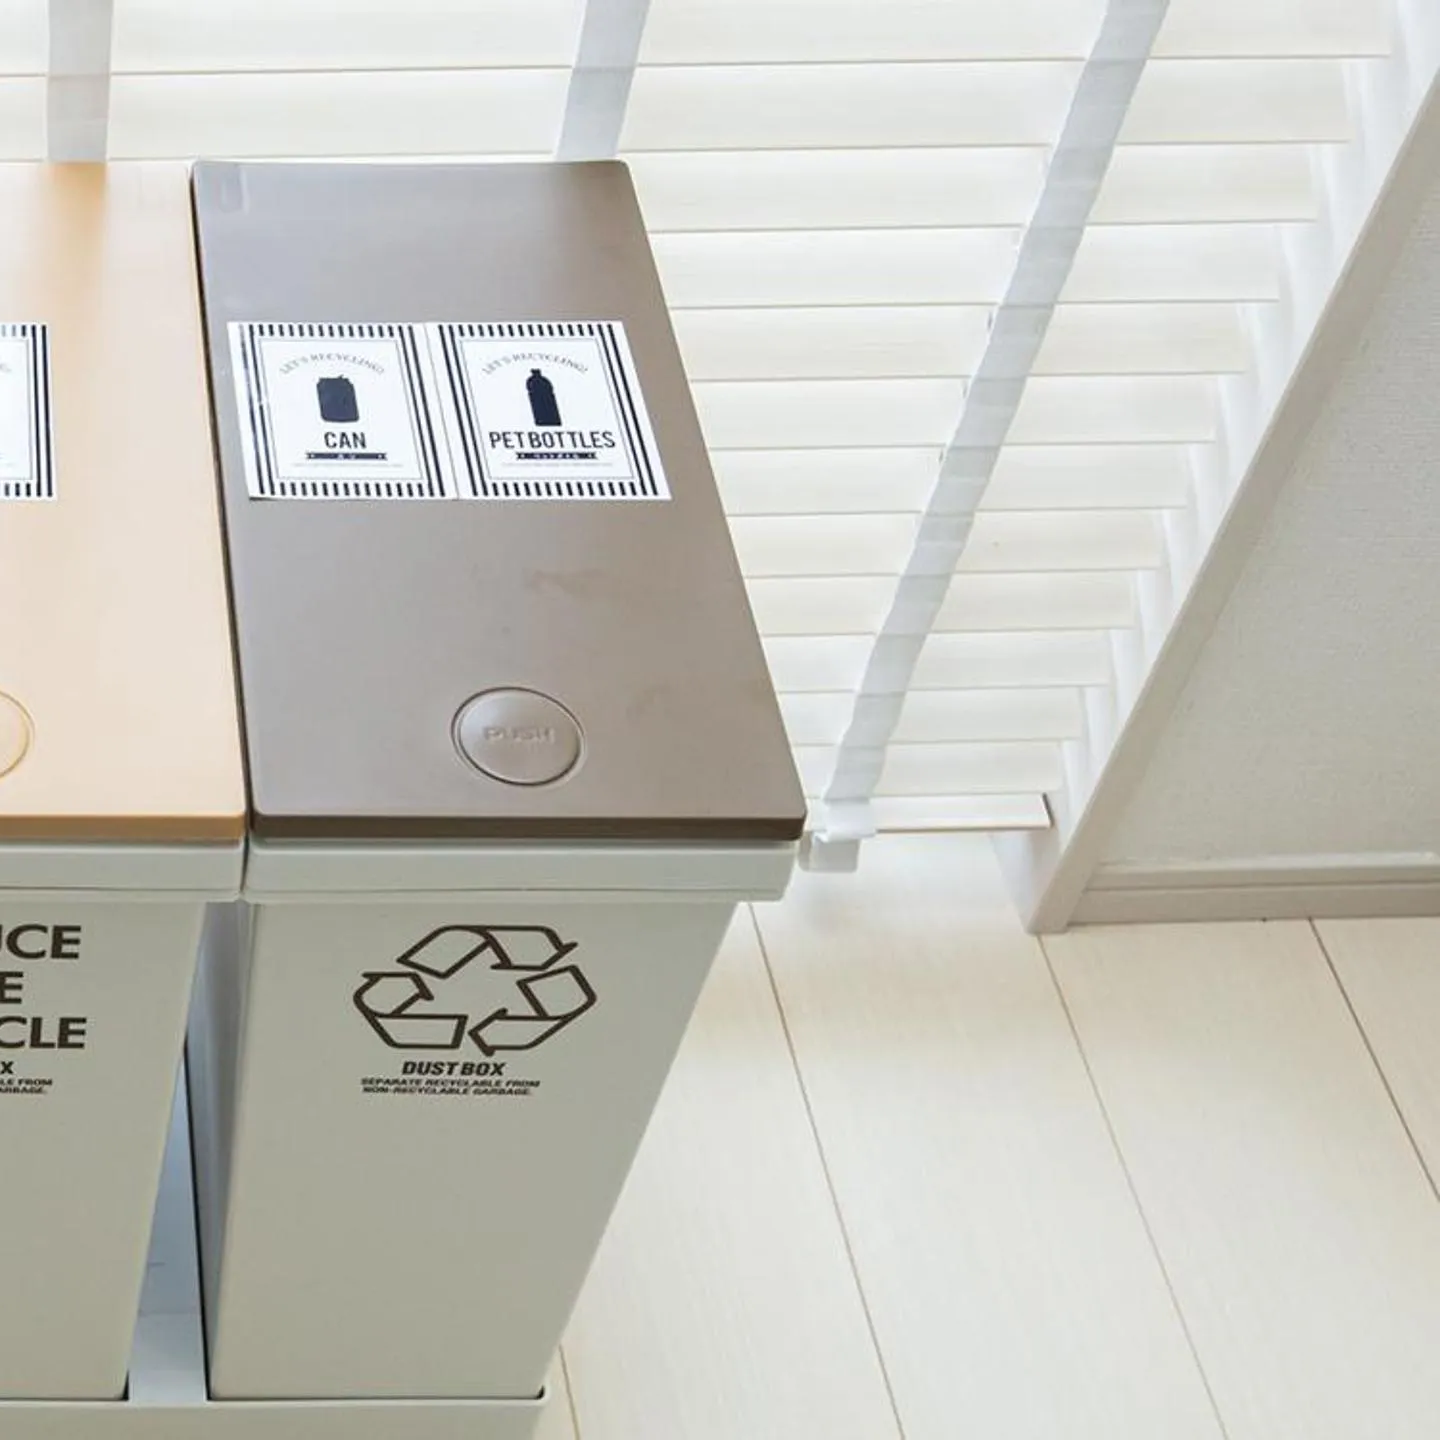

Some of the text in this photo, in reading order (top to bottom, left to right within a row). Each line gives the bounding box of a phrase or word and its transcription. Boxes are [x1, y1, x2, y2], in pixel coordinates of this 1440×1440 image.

[324, 431, 367, 449] CAN
[402, 1061, 506, 1076] DUST BOX
[18, 1078, 53, 1086] FROM
[361, 1078, 540, 1088] SEPARATE RECYCLABLE FROM
